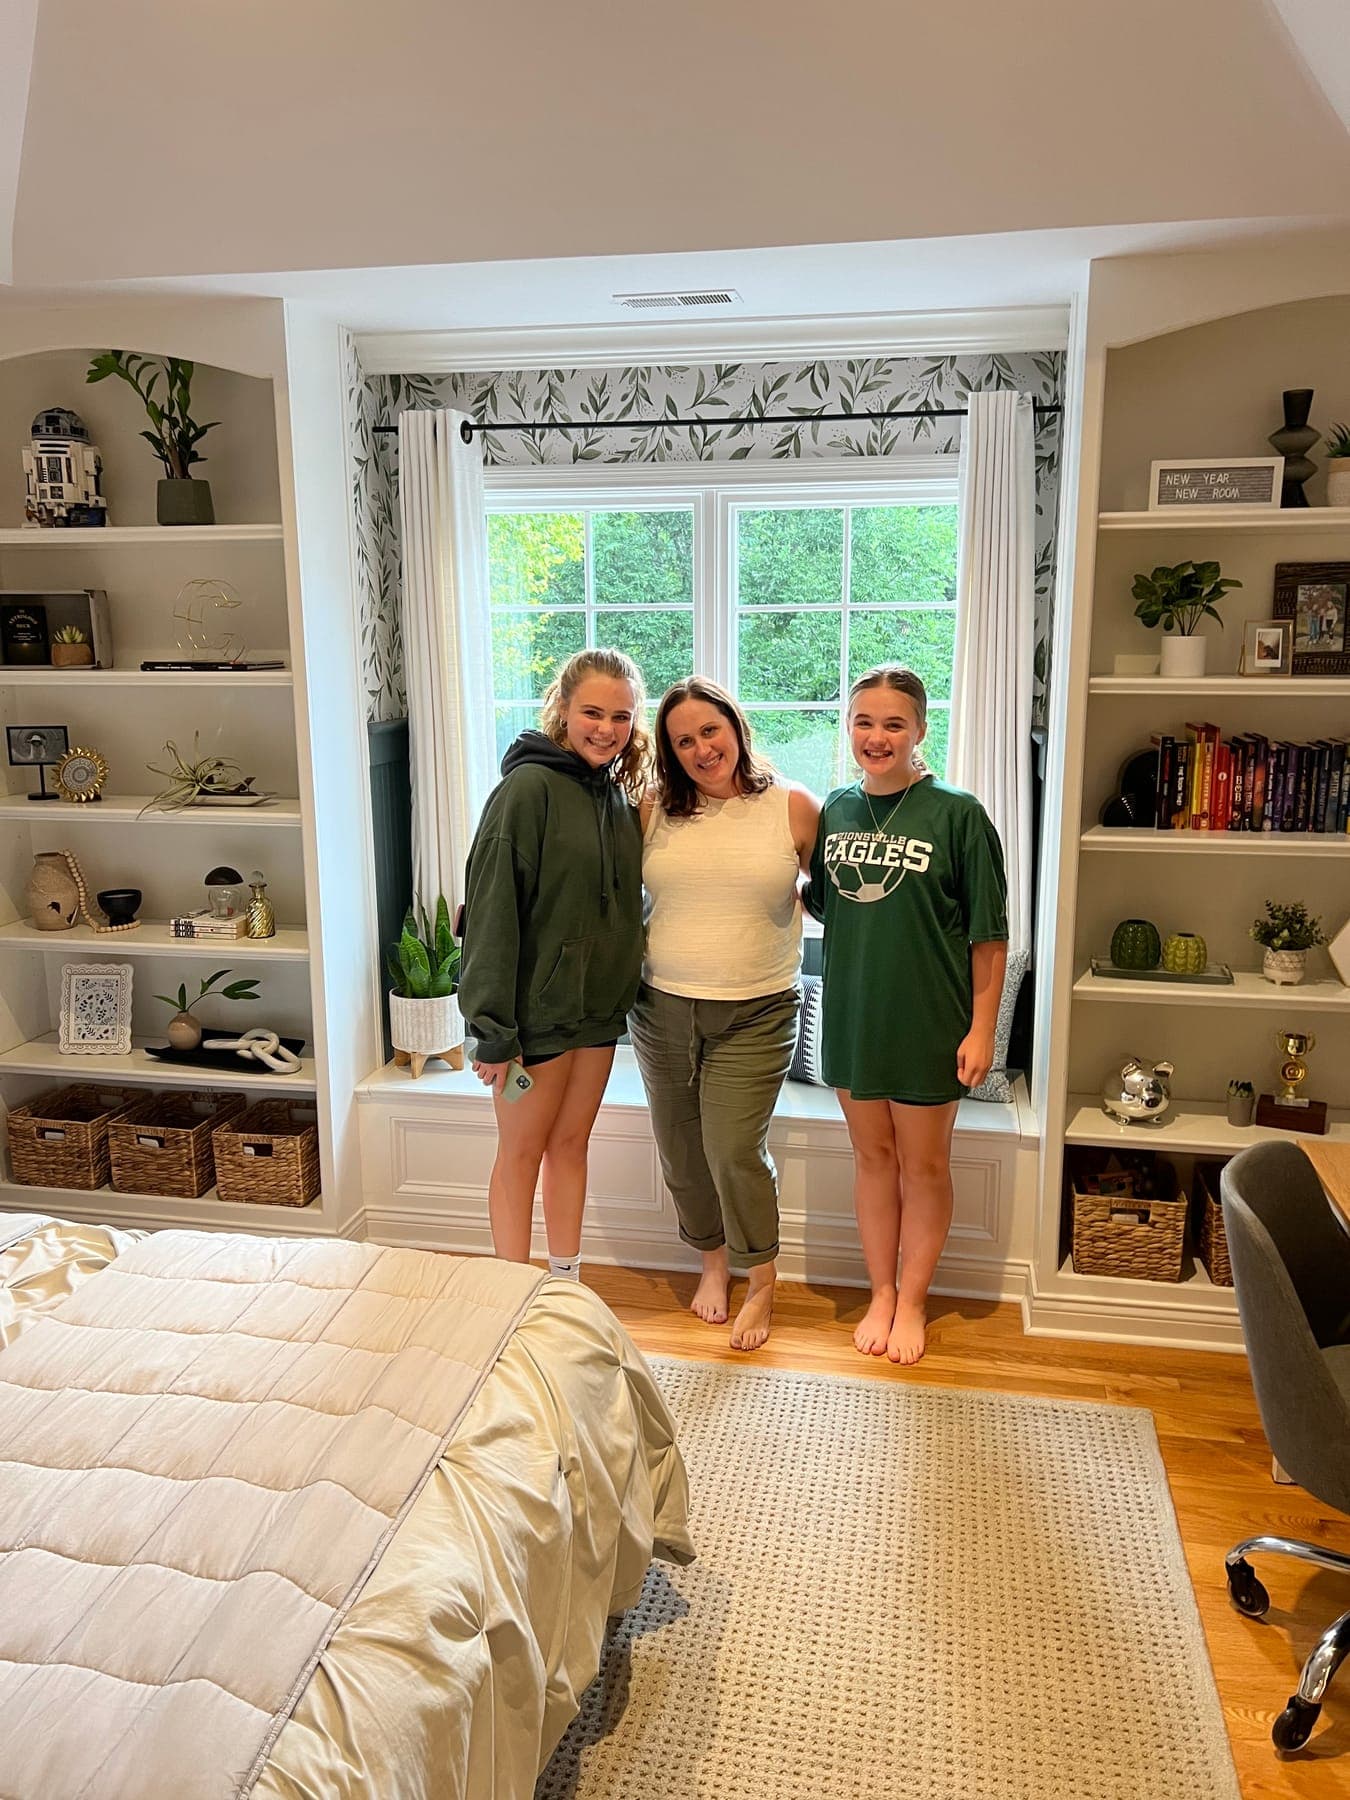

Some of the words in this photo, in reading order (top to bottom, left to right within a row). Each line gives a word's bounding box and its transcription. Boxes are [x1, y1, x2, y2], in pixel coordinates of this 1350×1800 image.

[1166, 474, 1190, 485] NEW
[1203, 473, 1229, 484] YEAR
[1175, 488, 1199, 499] NEW
[1212, 487, 1240, 499] ROOM
[824, 833, 933, 873] EAGLES
